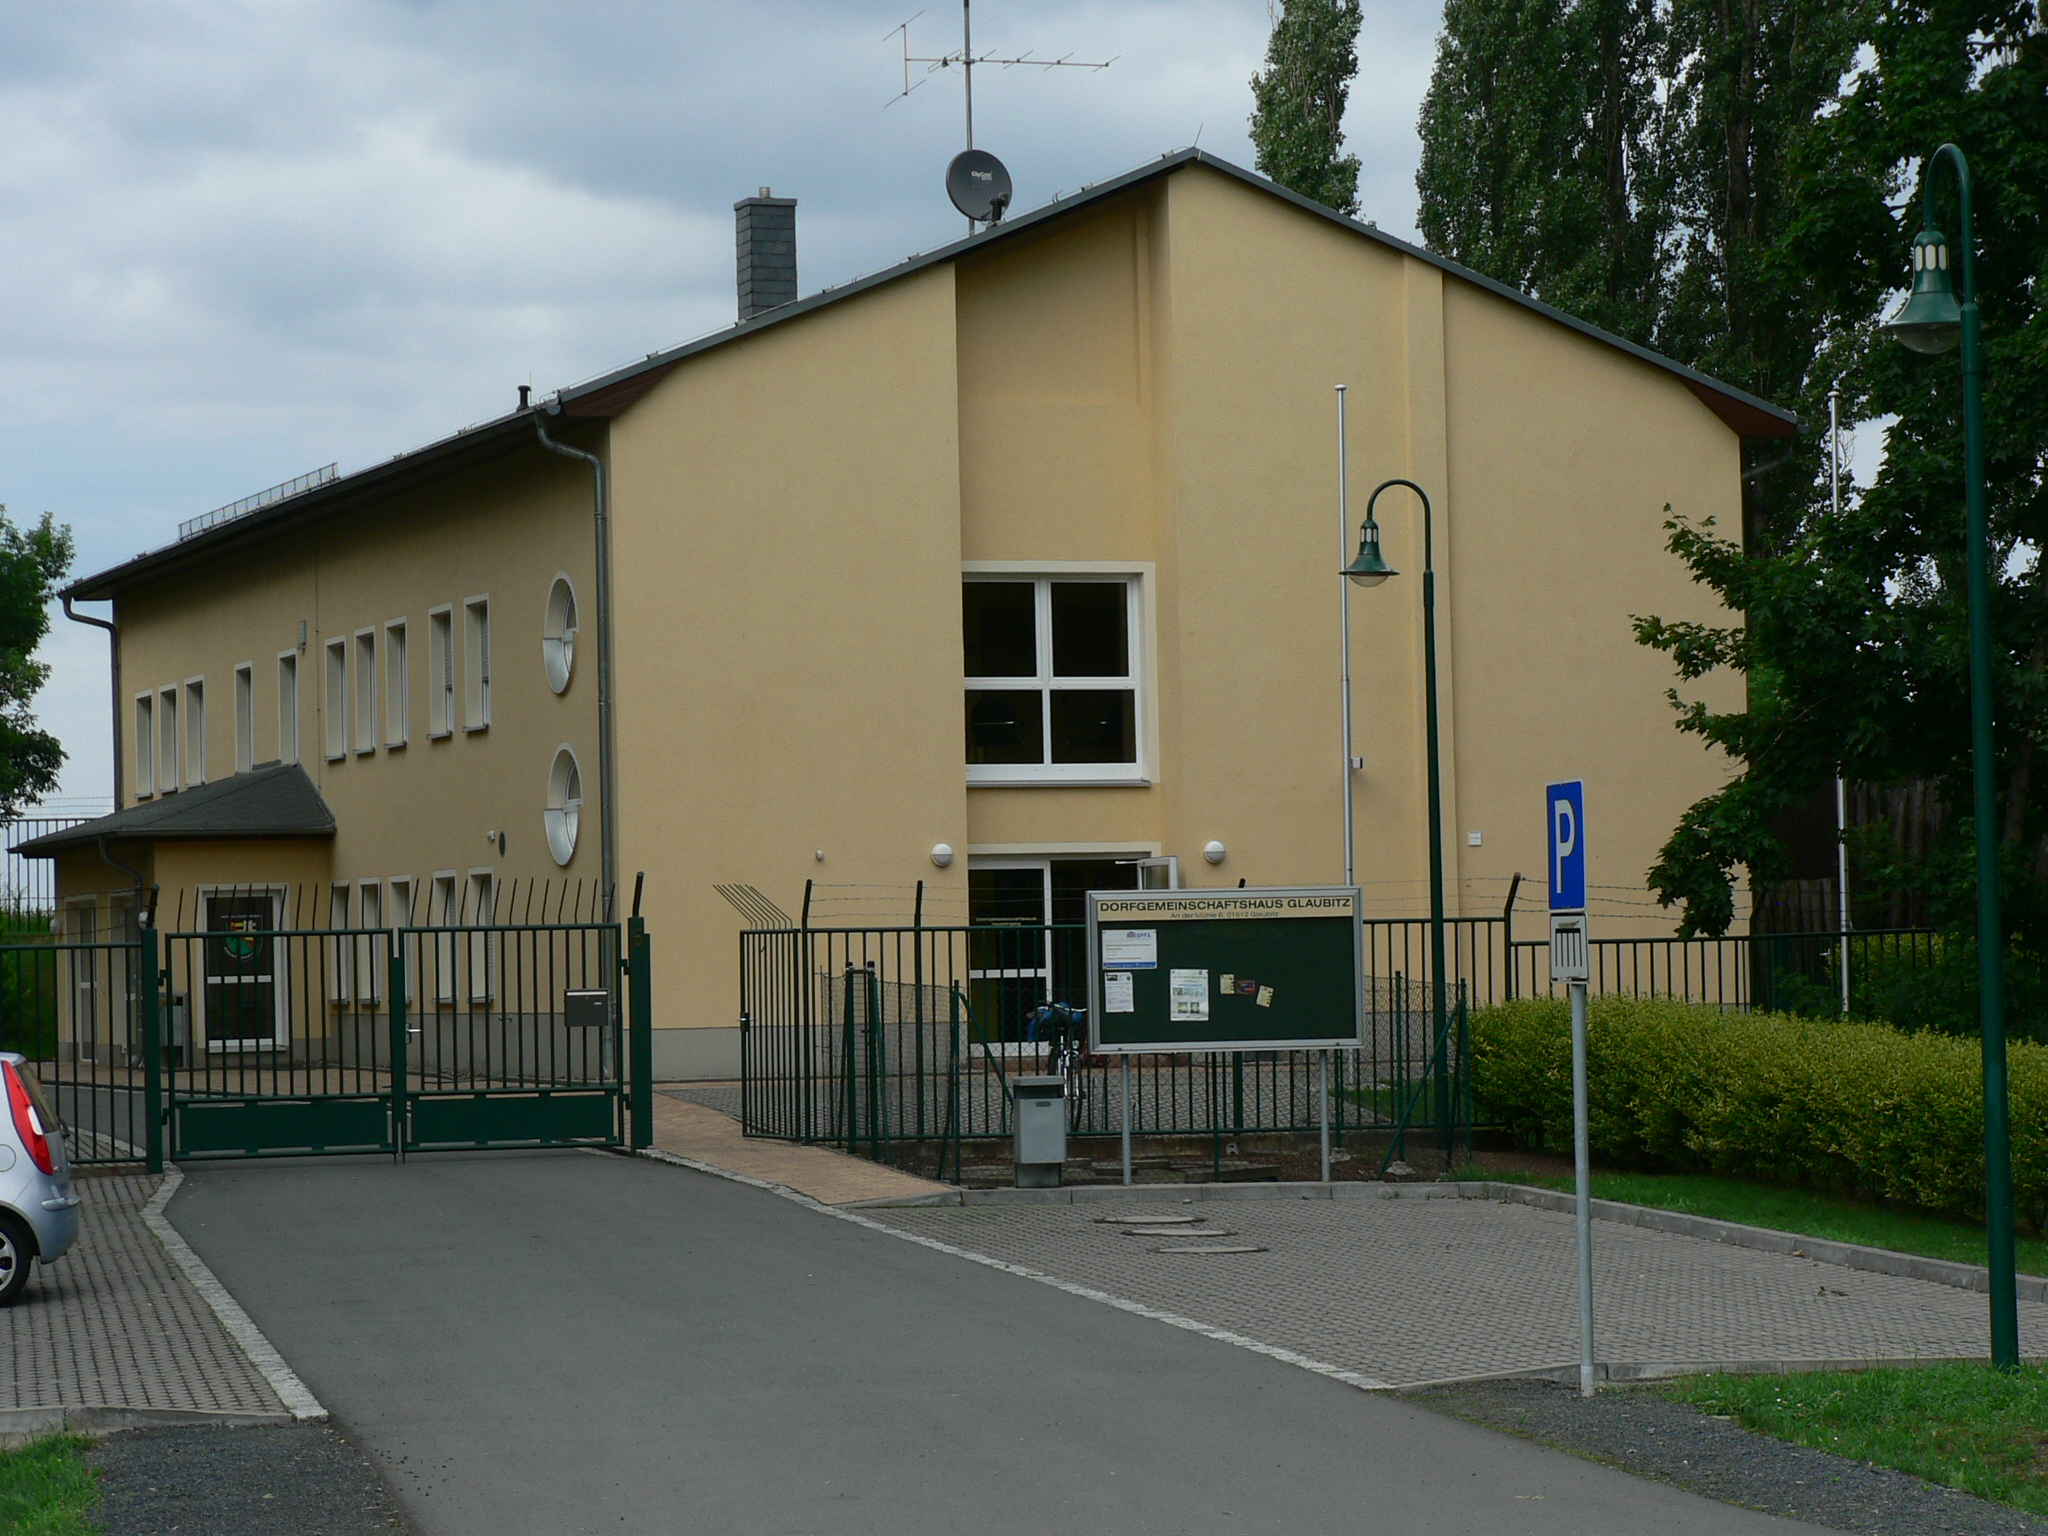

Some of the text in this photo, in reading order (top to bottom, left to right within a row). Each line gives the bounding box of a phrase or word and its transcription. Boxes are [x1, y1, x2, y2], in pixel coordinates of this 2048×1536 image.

[1554, 799, 1575, 894] P
[1100, 898, 1351, 912] DORFGEMEINSCHAFTSHAUS GLAUBITZ
